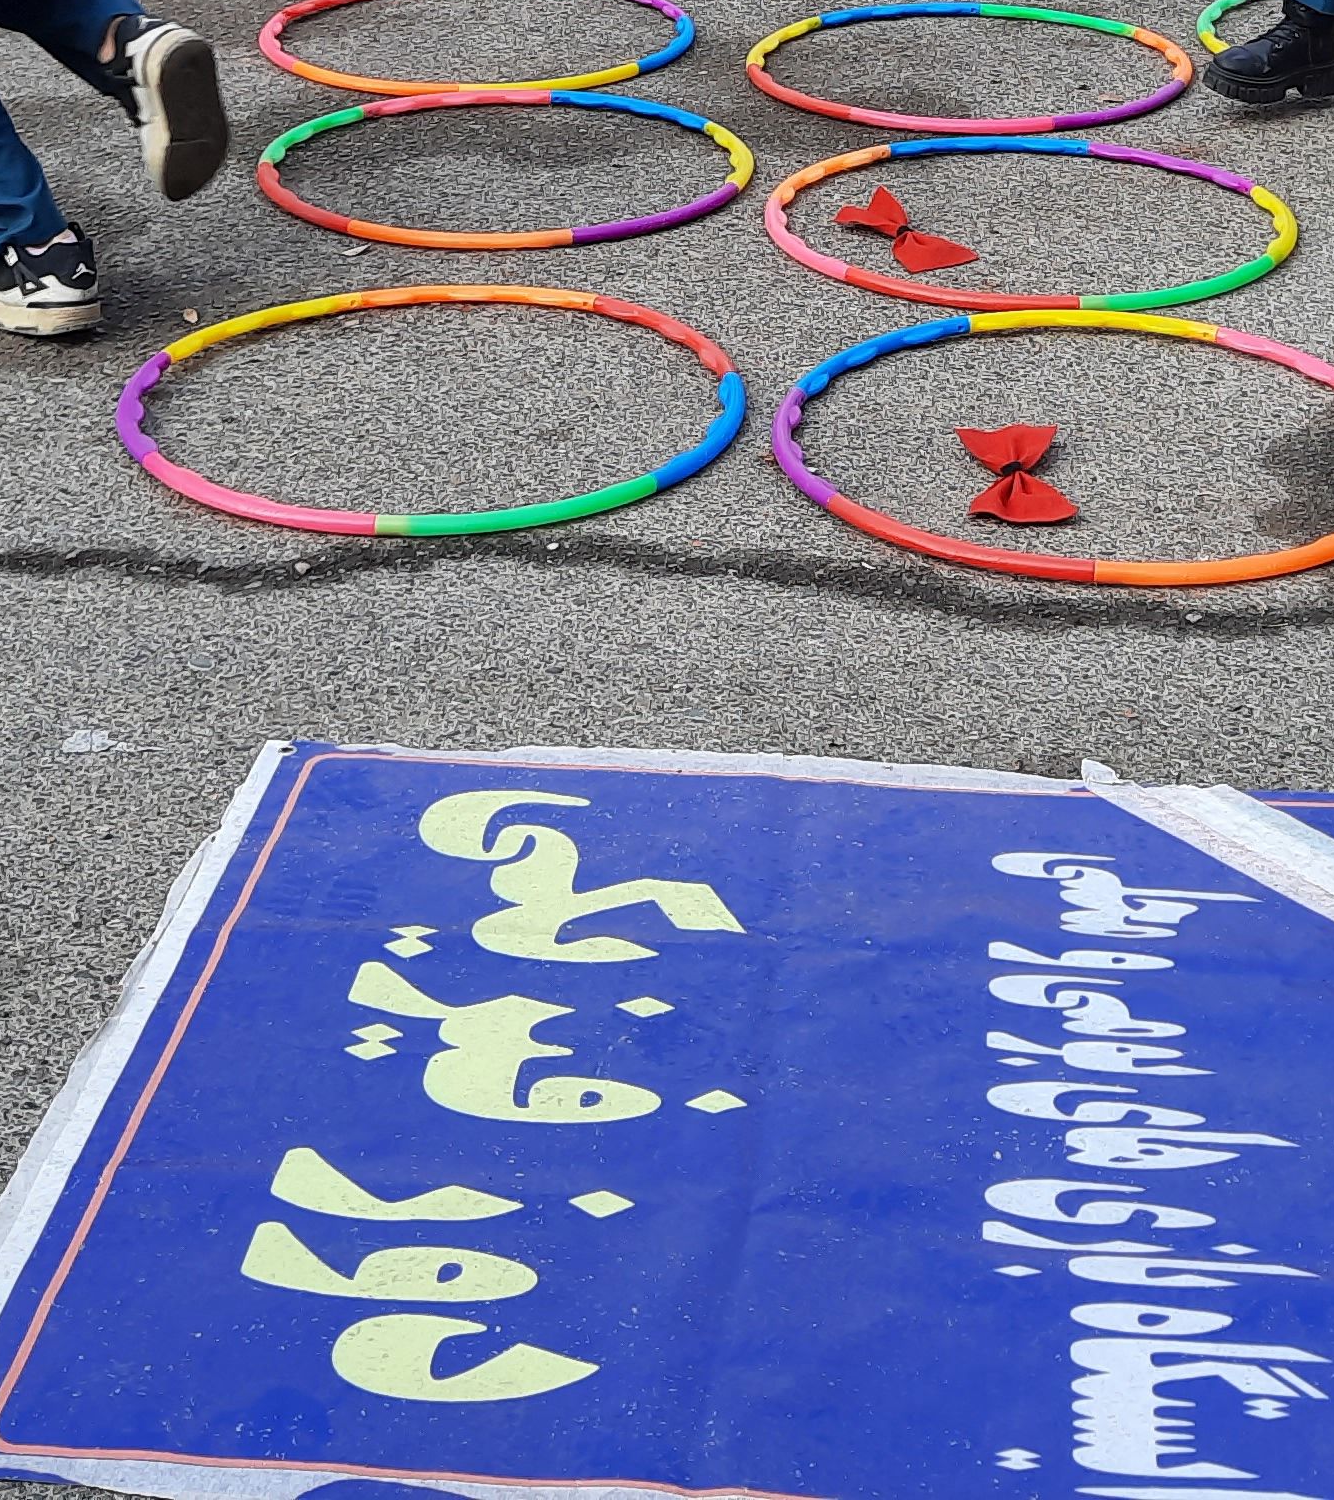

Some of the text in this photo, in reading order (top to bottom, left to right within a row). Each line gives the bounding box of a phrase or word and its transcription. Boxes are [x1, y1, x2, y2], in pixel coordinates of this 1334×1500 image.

[240, 789, 748, 1403] دوز فیزیکی
[982, 851, 1331, 1500] ایستگاه بازی های بومی و محلی
